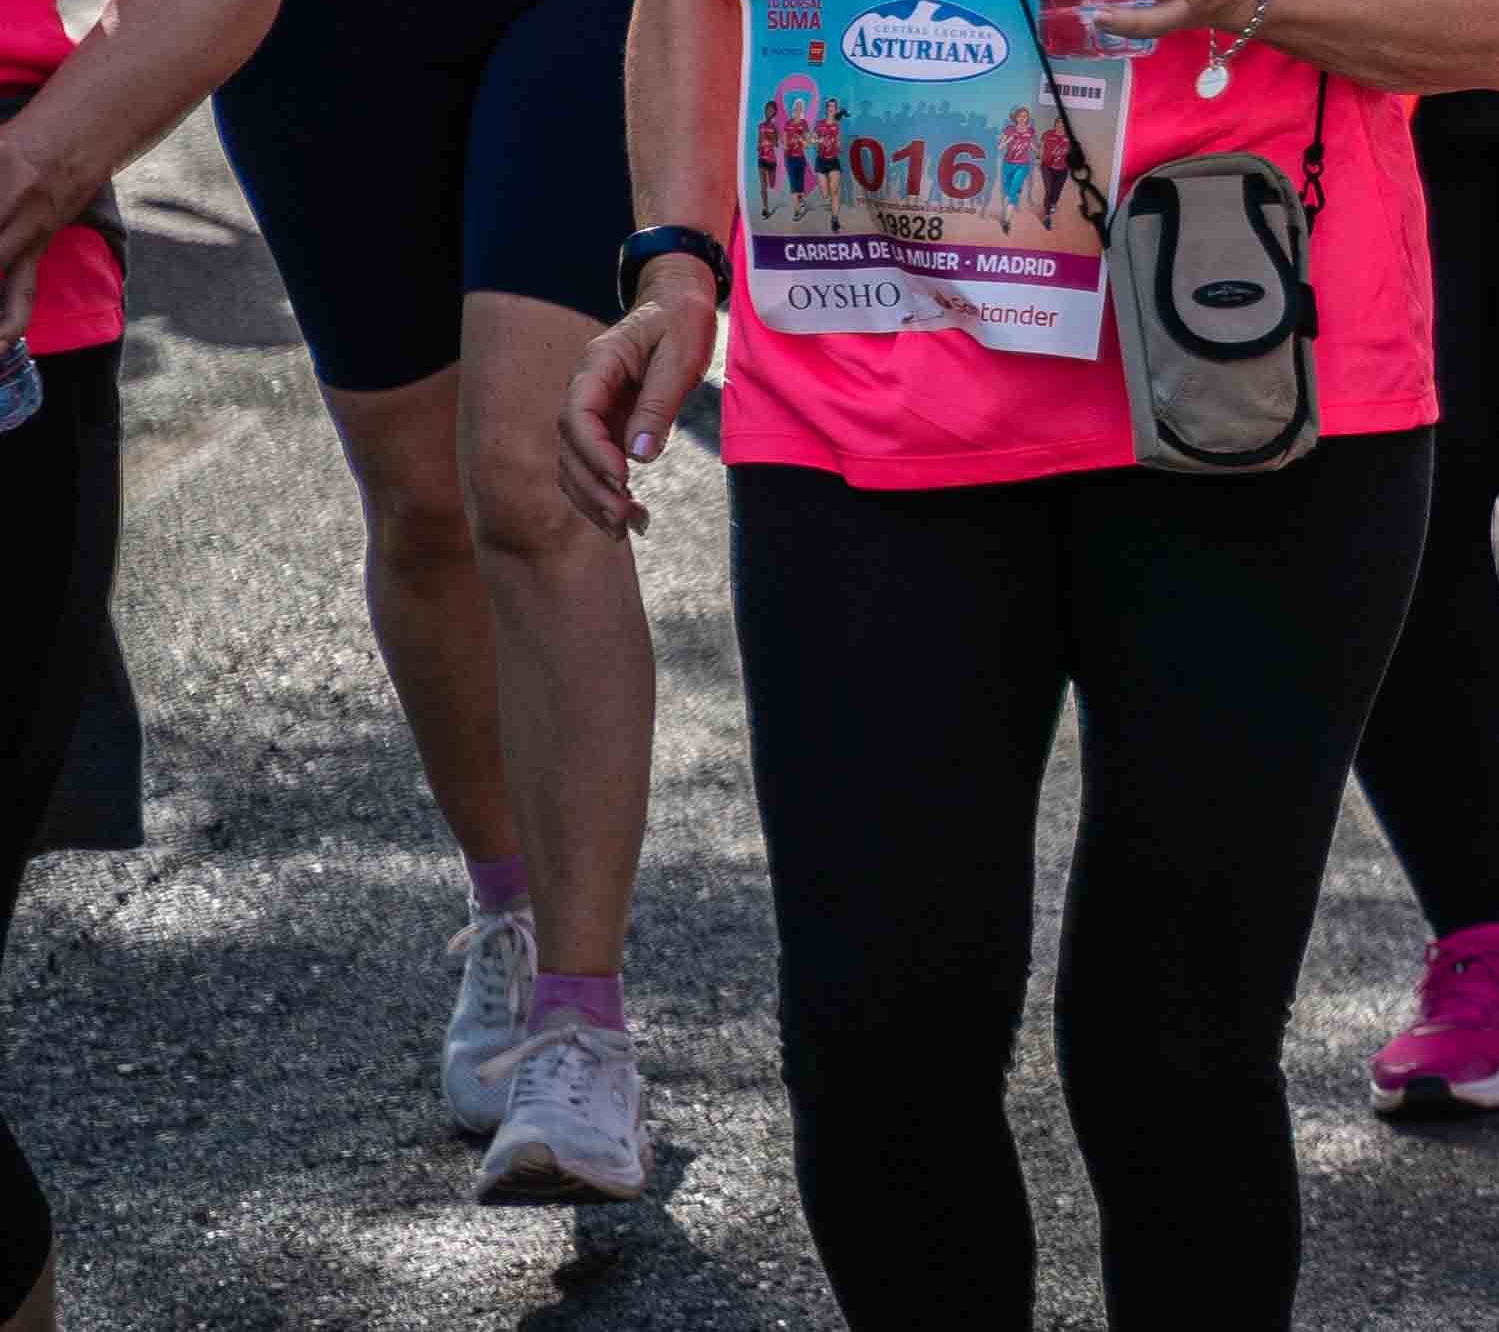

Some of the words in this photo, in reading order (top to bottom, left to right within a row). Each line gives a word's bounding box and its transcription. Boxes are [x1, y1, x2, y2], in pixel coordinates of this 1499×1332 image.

[767, 10, 822, 30] SUMA
[850, 26, 995, 64] ASTURIANA
[850, 137, 987, 199] 016
[876, 210, 943, 241] 19828
[784, 242, 864, 262] CARRERA
[869, 241, 890, 260] DE
[904, 250, 959, 271] MUJER
[976, 254, 1056, 277] MADRID
[788, 282, 901, 310] OYSHO
